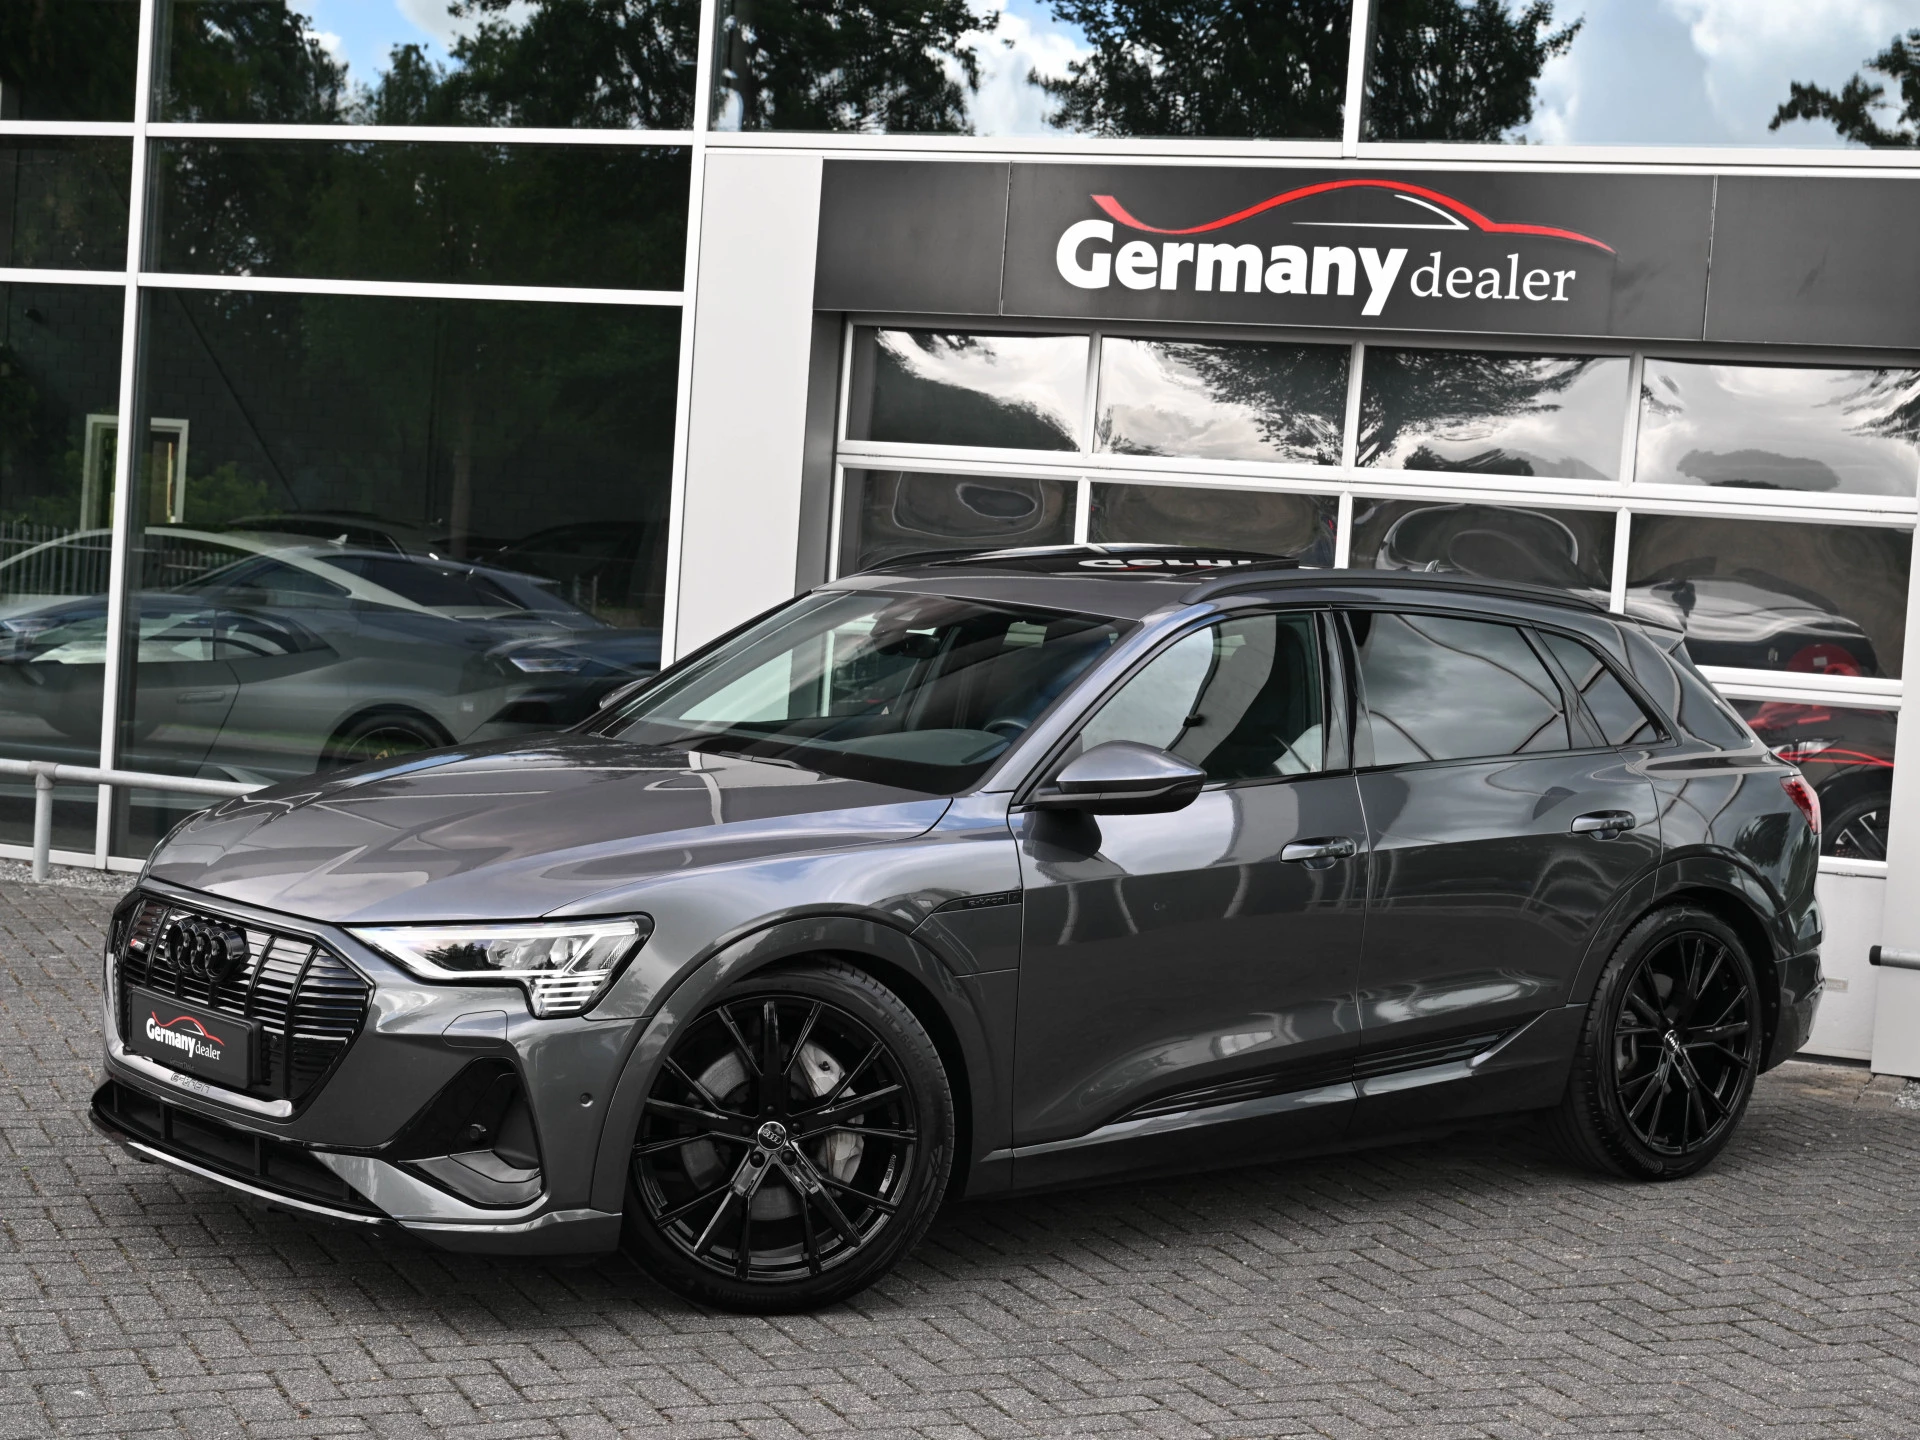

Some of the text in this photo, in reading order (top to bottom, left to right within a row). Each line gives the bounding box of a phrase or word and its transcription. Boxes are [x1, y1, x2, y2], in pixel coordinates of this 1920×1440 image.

[1055, 219, 1577, 316] Germany dealer
[145, 1017, 221, 1060] Germany dealer
[896, 1028, 924, 1068] 265/40
[170, 1071, 211, 1094] e-tron
